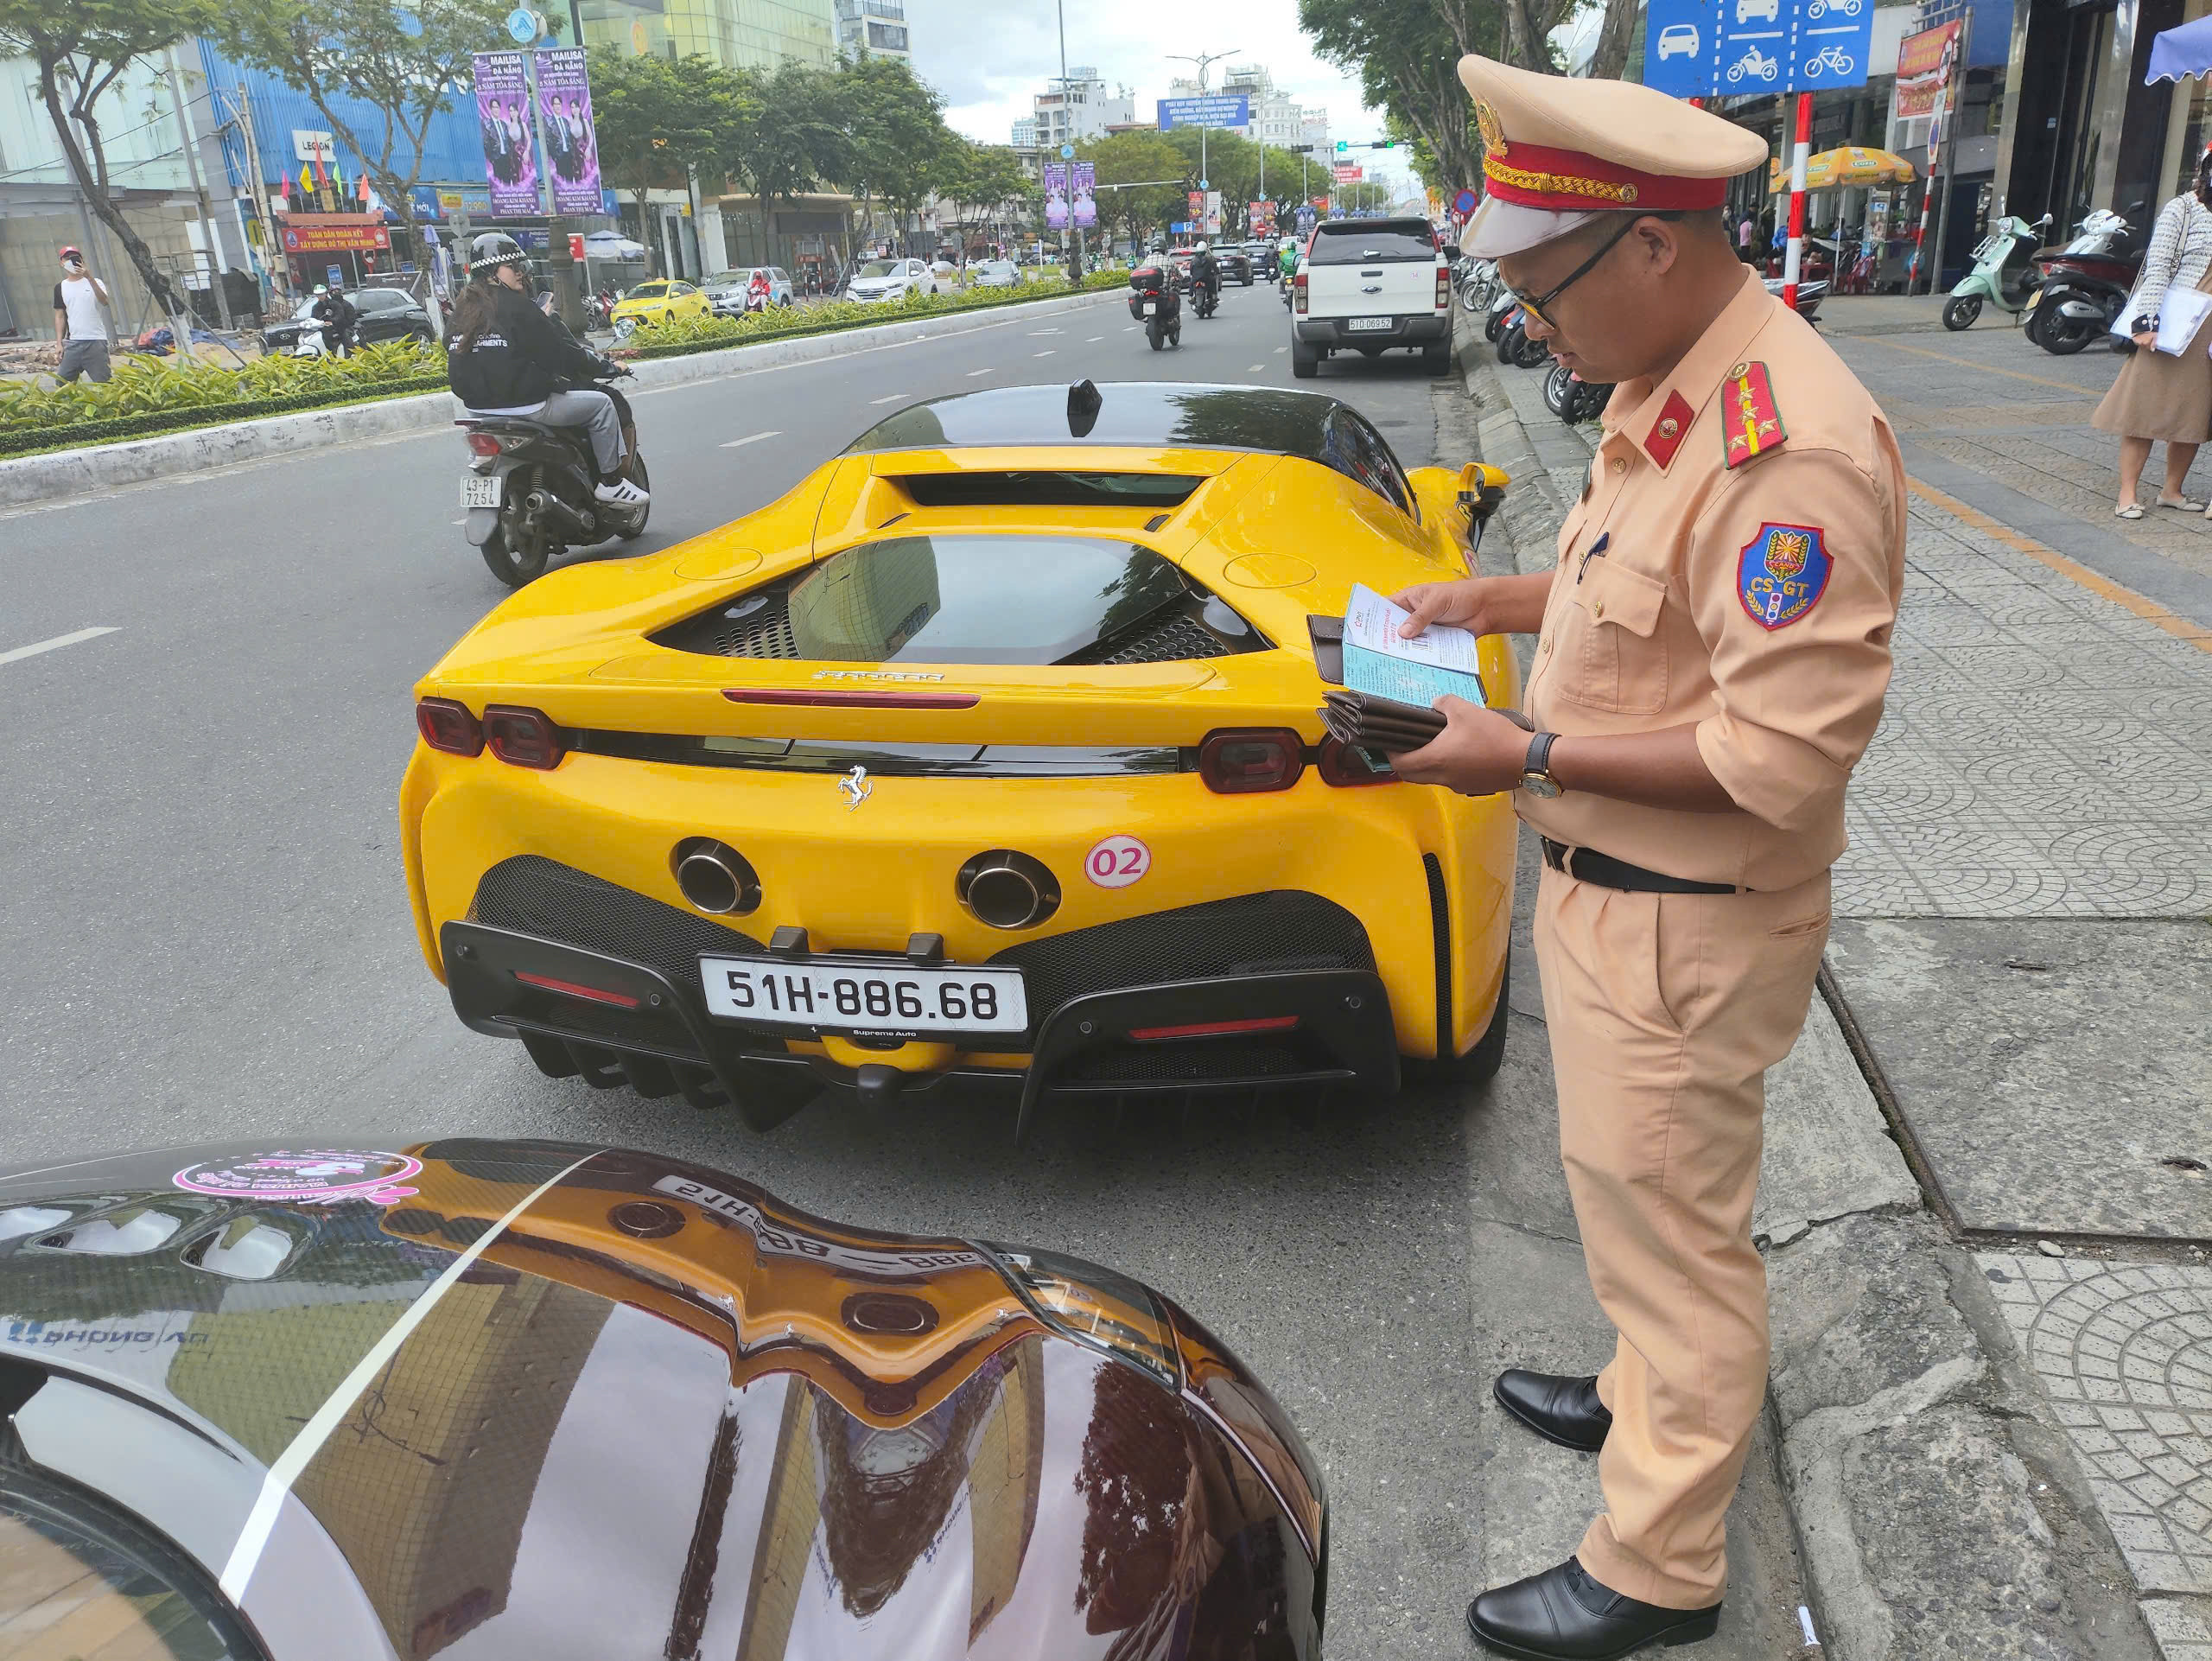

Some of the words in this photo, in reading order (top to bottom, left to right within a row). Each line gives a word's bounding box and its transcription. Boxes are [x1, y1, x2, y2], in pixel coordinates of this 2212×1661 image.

[490, 55, 522, 65] MAILISA
[551, 51, 583, 60] MAILISA
[554, 62, 564, 71] ĐÀ
[302, 141, 330, 150] LEGON
[353, 228, 364, 237] KẾT
[1185, 223, 1191, 232] P
[2171, 248, 2183, 268] KORS
[467, 479, 493, 491] 43-P1
[467, 493, 493, 505] 7254
[1751, 577, 1774, 593] CS
[1783, 581, 1809, 598] GT
[1092, 847, 1141, 876] 02
[727, 970, 998, 1020] 51H-886.68
